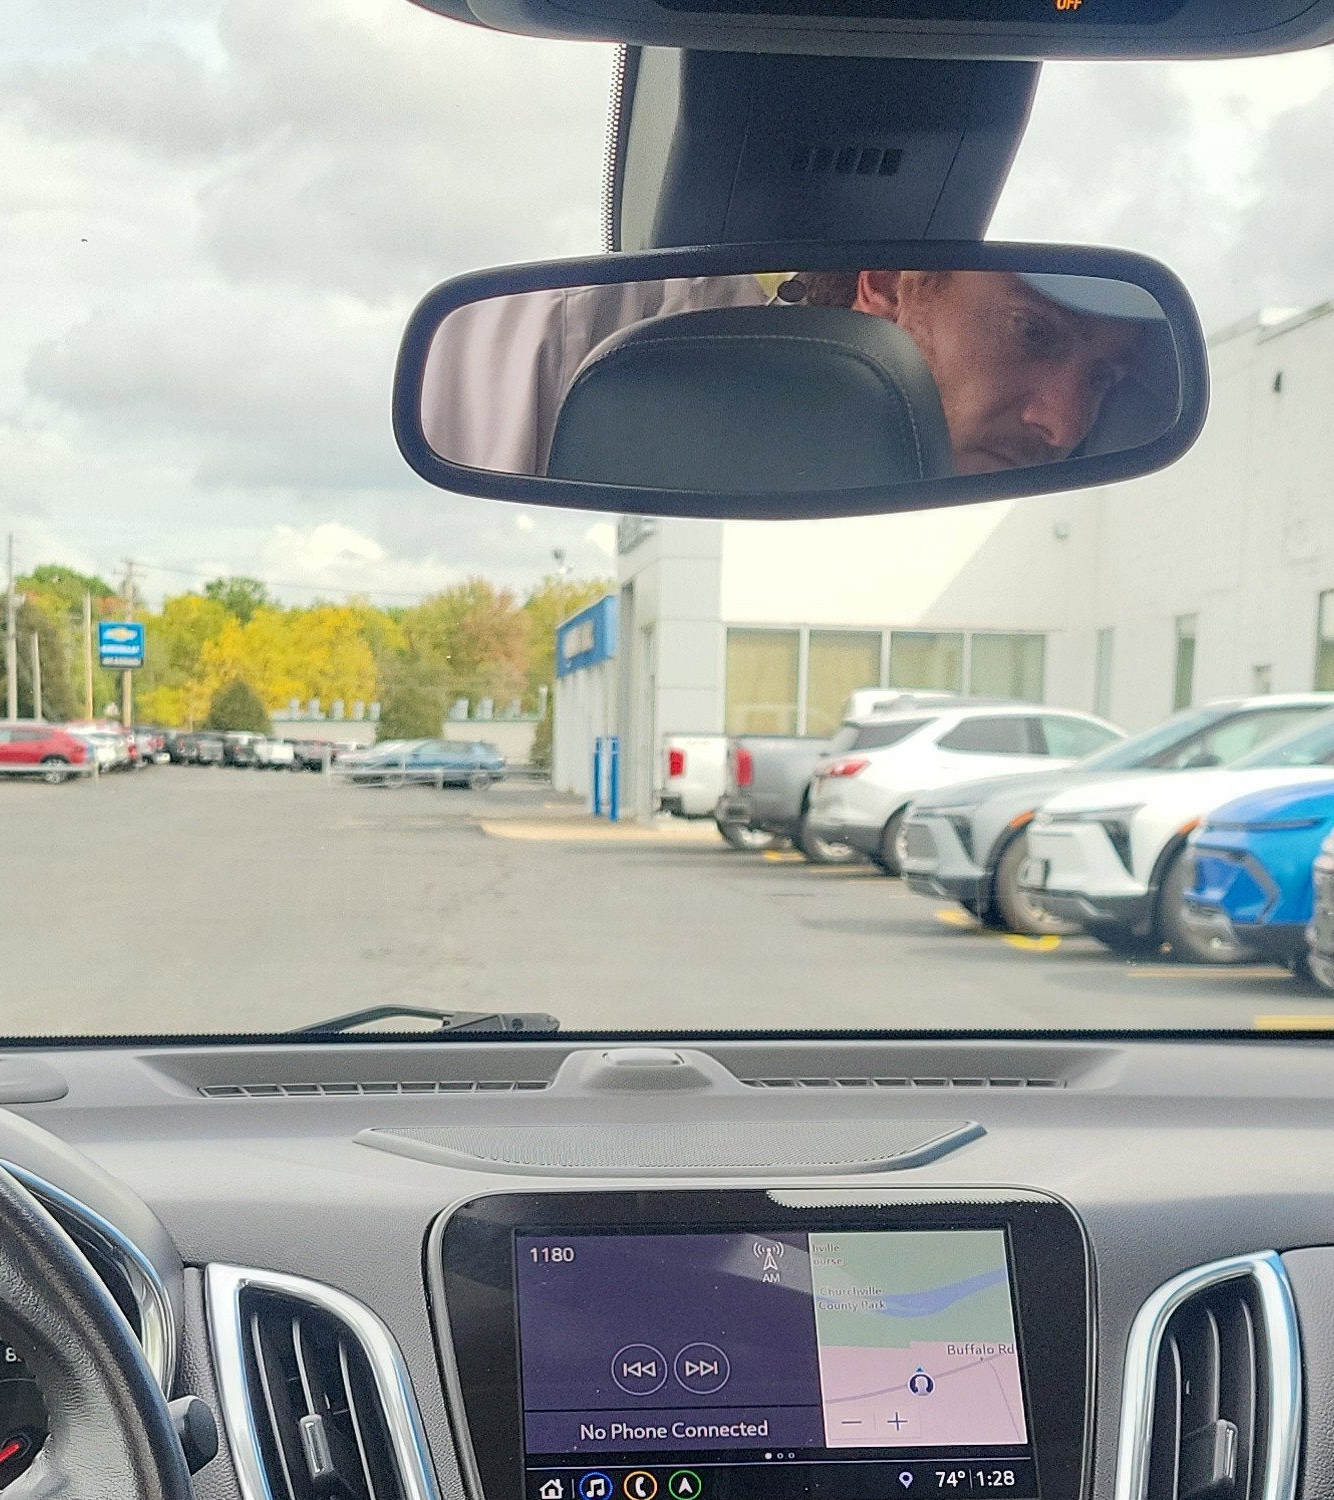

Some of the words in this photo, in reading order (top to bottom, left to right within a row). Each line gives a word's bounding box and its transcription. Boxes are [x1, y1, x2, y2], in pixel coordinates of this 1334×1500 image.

[530, 1247, 575, 1263] 1180
[762, 1273, 781, 1283] AM
[820, 1286, 882, 1296] Churchville
[818, 1300, 858, 1312] County
[861, 1300, 886, 1311] Park
[947, 1343, 995, 1356] Buffalo
[998, 1343, 1015, 1355] Rd
[580, 1424, 607, 1441] No
[611, 1423, 668, 1440] Phone
[671, 1420, 769, 1438] Connected
[935, 1470, 966, 1488] 74°
[976, 1470, 1015, 1487] 1:28
